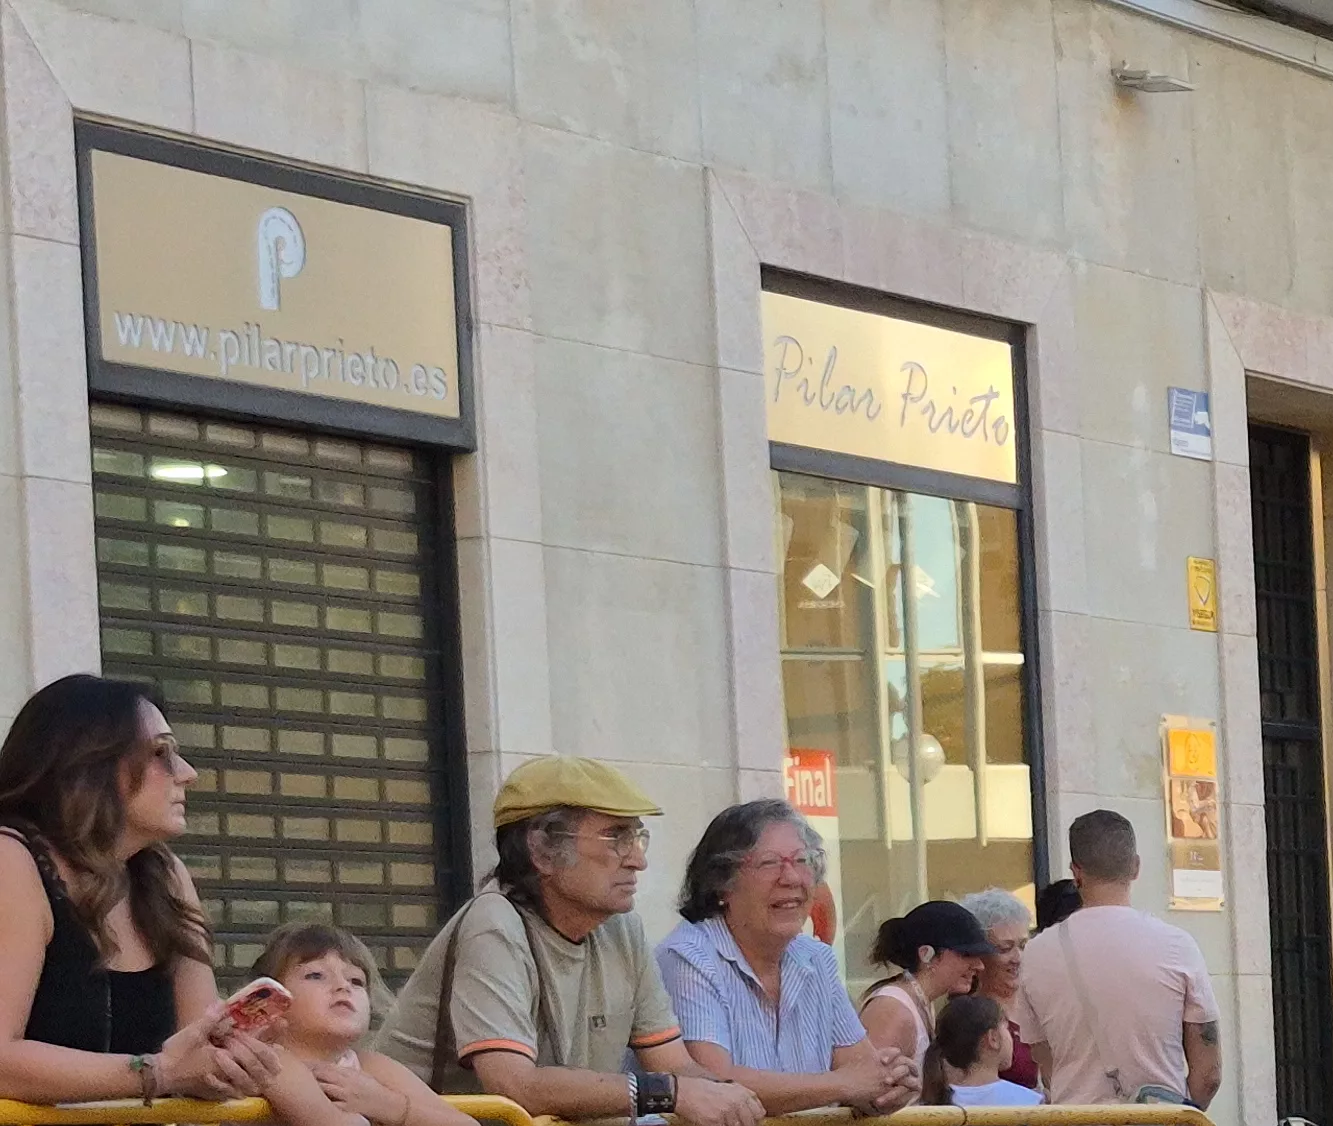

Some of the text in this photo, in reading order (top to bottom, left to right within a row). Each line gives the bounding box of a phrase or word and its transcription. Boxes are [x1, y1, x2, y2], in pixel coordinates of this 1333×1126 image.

[113, 310, 448, 400] www.pilarprieto.es
[773, 335, 1010, 447] Pilar Prieto
[783, 755, 832, 807] Final
